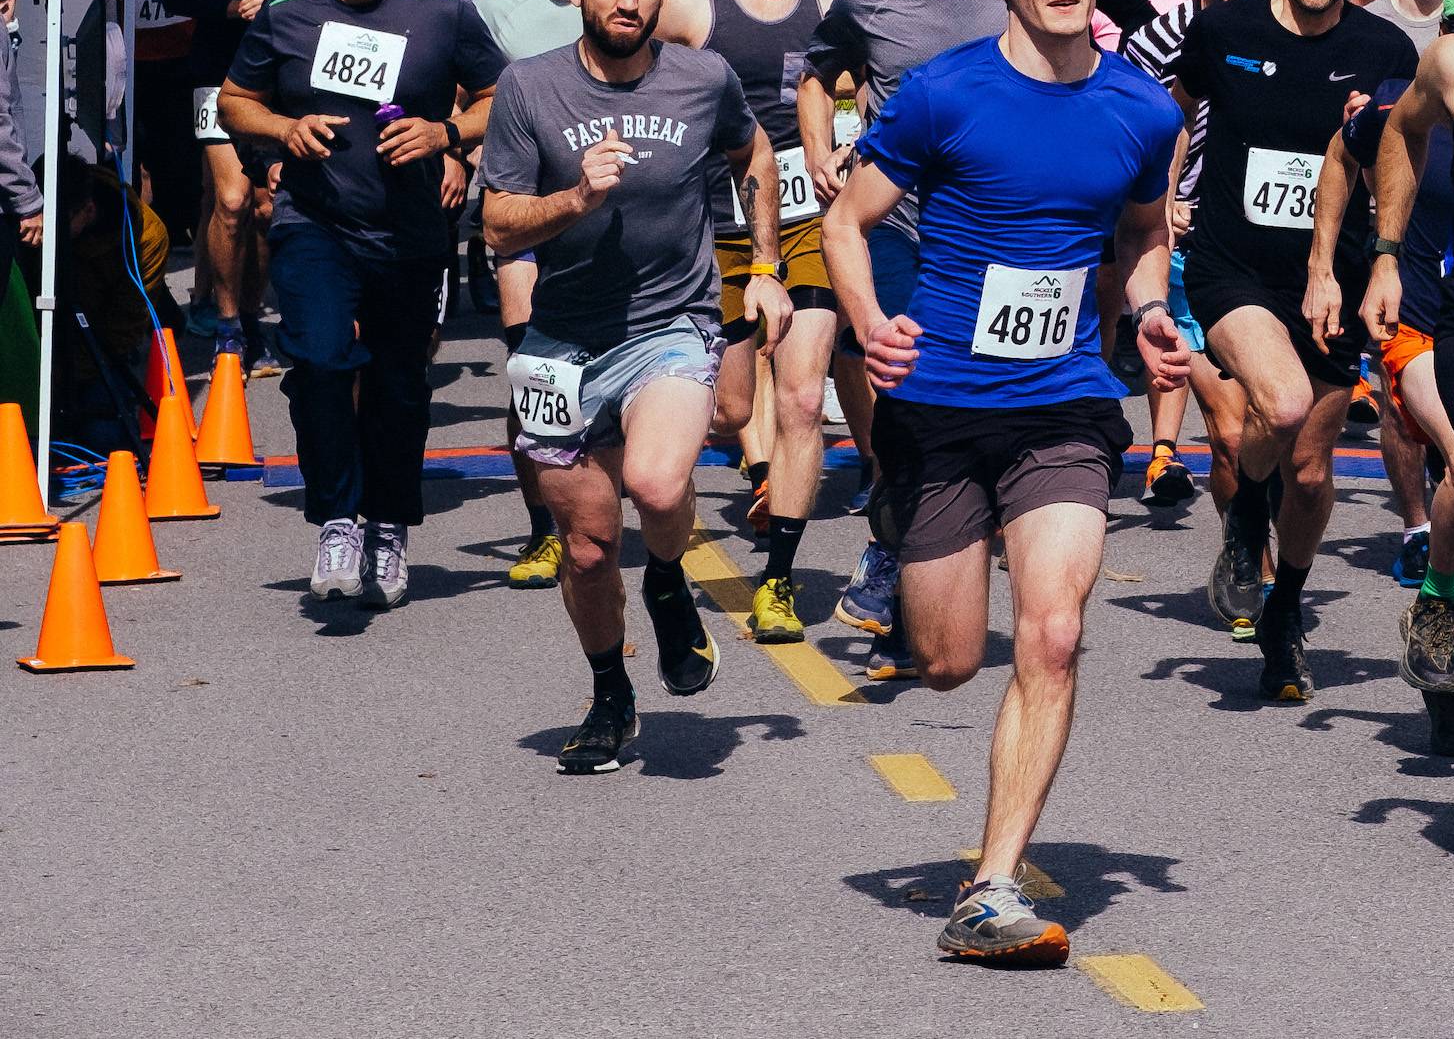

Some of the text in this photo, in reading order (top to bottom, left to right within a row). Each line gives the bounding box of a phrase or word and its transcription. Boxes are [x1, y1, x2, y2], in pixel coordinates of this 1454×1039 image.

[322, 51, 388, 90] 4824
[563, 114, 688, 151] FAST BREAK
[638, 151, 652, 159] 1977
[1305, 169, 1312, 178] 6
[1053, 287, 1062, 299] 6
[988, 305, 1070, 345] 4816
[549, 374, 556, 385] 6
[519, 386, 571, 426] 4758
